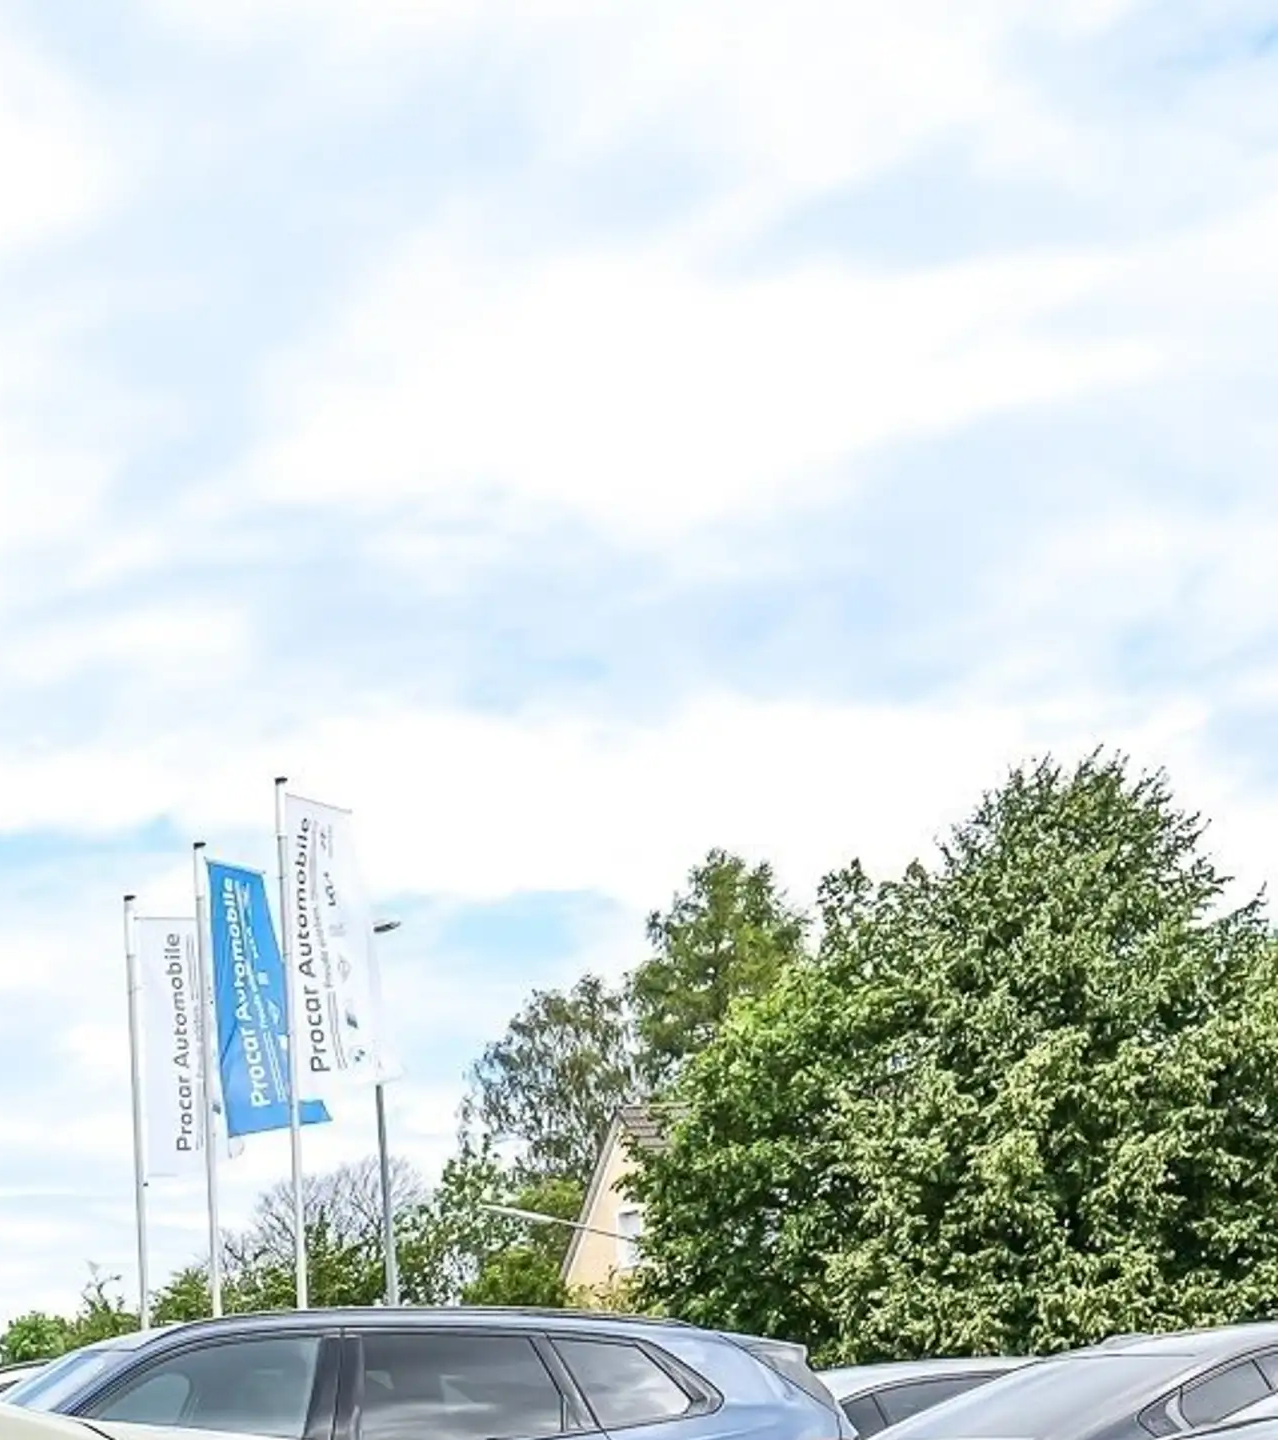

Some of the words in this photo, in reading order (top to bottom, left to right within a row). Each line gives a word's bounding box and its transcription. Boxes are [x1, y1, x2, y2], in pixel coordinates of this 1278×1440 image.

[222, 877, 253, 1022] Automobile
[295, 818, 316, 978] Automobile
[165, 933, 189, 1069] Automobile
[304, 985, 330, 1072] Procar
[176, 1077, 193, 1151] Procar
[241, 1027, 270, 1108] Procar
